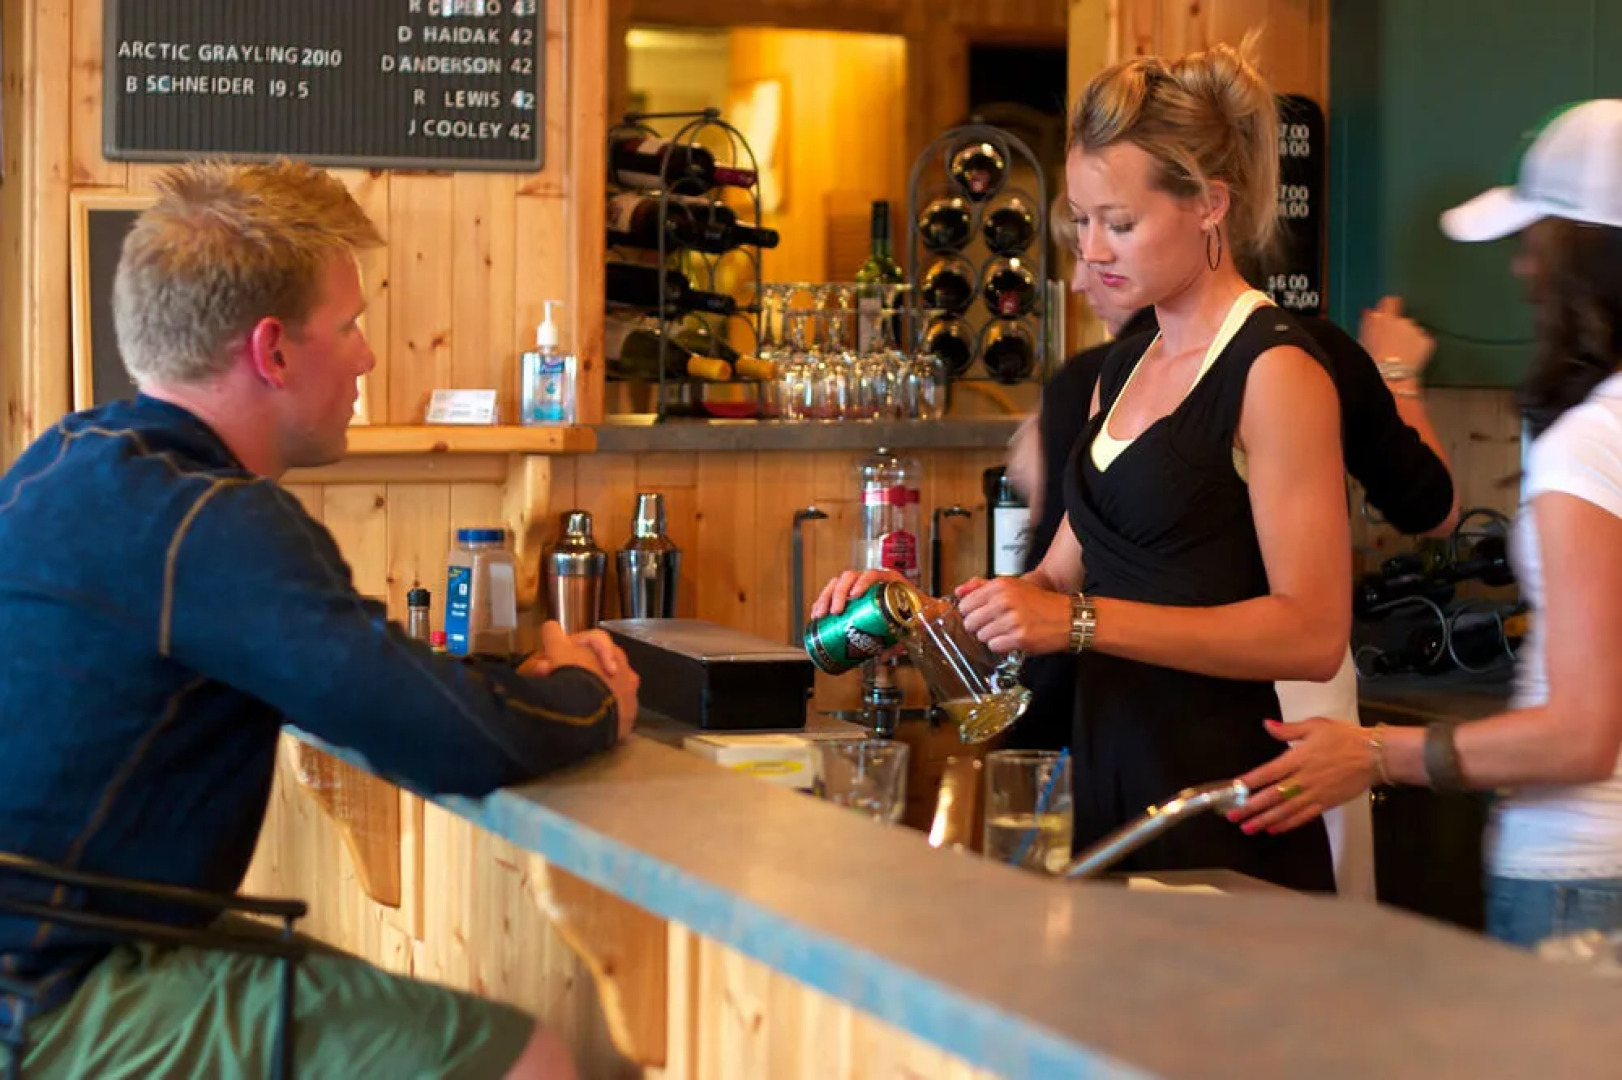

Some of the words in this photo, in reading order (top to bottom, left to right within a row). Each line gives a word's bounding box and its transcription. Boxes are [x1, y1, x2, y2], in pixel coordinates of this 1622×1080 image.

[398, 25, 413, 42] D
[423, 25, 500, 45] HAIDAK
[509, 28, 533, 46] 42
[118, 41, 192, 61] ARCTIC
[198, 44, 298, 64] GRAYLING
[301, 49, 343, 67] 2010
[381, 54, 395, 72] D
[398, 56, 502, 74] ANDERSON
[510, 57, 533, 74] 42
[126, 75, 138, 93] B
[145, 75, 254, 95] SCHNEIDER
[413, 88, 426, 105] R
[444, 90, 501, 108] LEWIS
[510, 89, 535, 110] 42
[408, 119, 416, 137] J
[423, 119, 502, 139] COOLEY
[508, 122, 531, 141] 42
